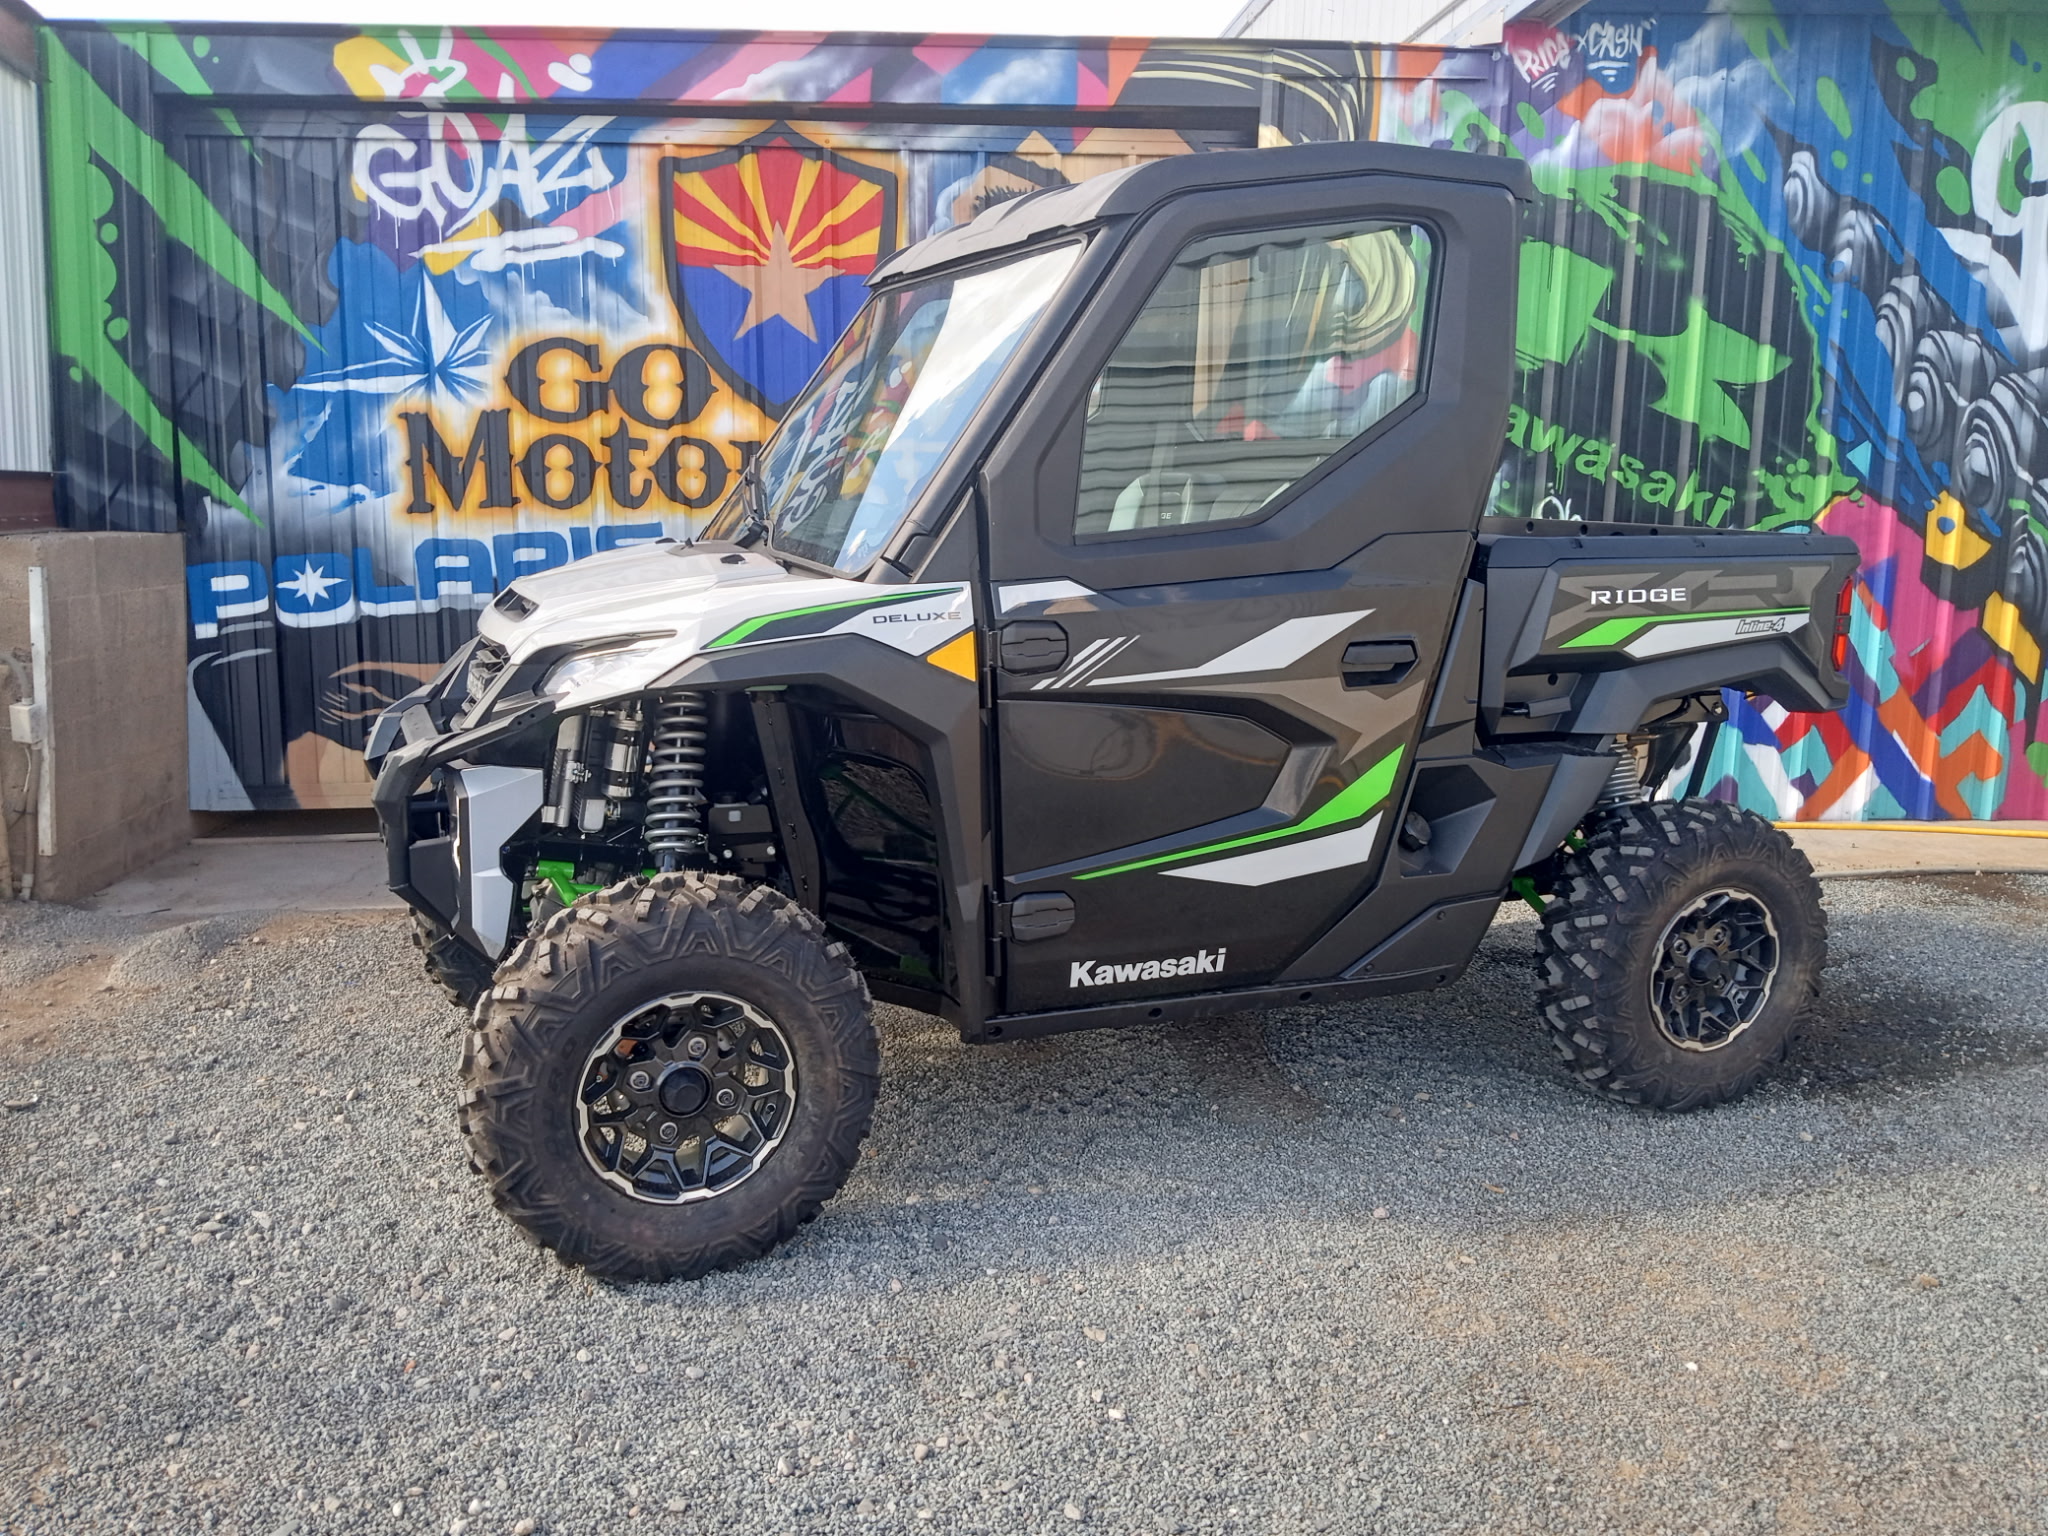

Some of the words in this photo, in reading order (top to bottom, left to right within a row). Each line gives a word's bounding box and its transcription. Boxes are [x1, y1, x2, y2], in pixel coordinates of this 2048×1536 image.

[1505, 403, 1736, 528] awasaki
[1590, 587, 1687, 605] RIDGE
[872, 611, 962, 624] DELUXE
[1069, 947, 1227, 988] Kawasaki
